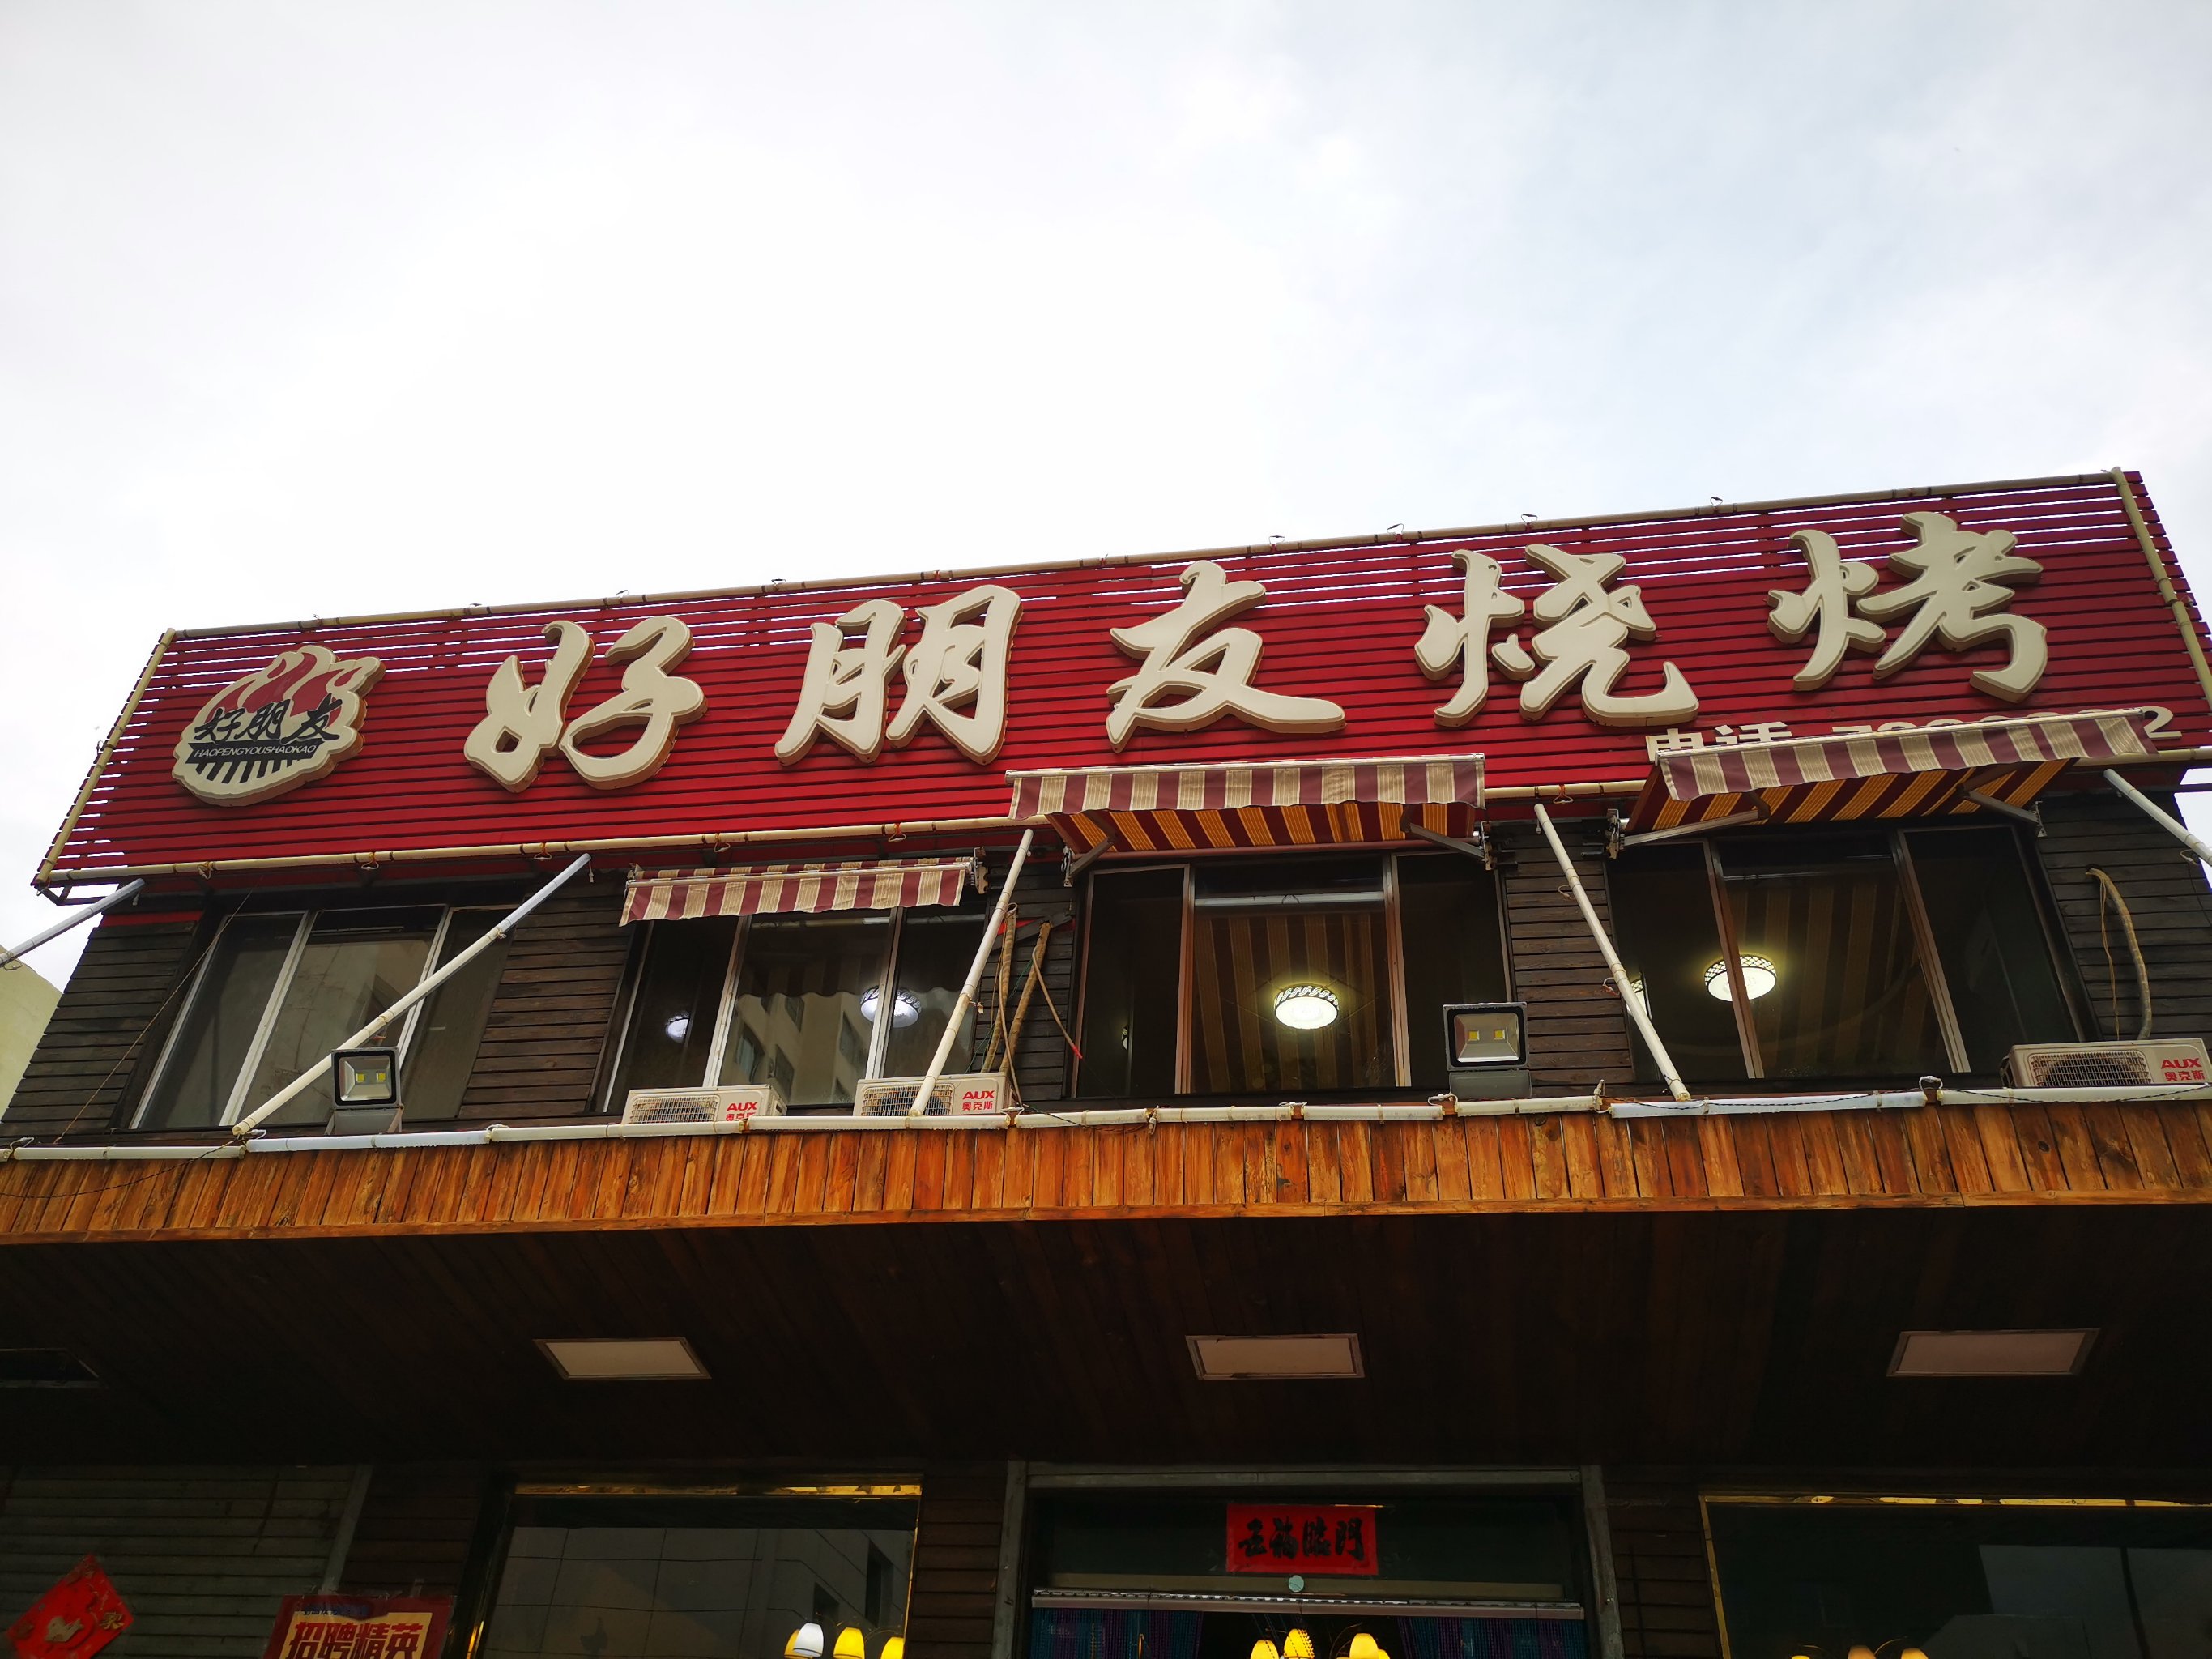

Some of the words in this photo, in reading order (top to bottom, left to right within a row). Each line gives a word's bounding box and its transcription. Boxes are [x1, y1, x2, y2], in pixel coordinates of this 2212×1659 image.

[464, 512, 2048, 792] 好朋友烧烤
[194, 693, 343, 744] 好朋友
[194, 744, 318, 757] HAOPENGYOUSHAOKAO
[2161, 1058, 2202, 1069] AUX
[2164, 1070, 2206, 1081] 奥克斯
[962, 1090, 995, 1100] AUX
[726, 1102, 758, 1111] AUX
[962, 1101, 993, 1111] 奥克斯
[285, 1621, 424, 1659] 招聘精英
